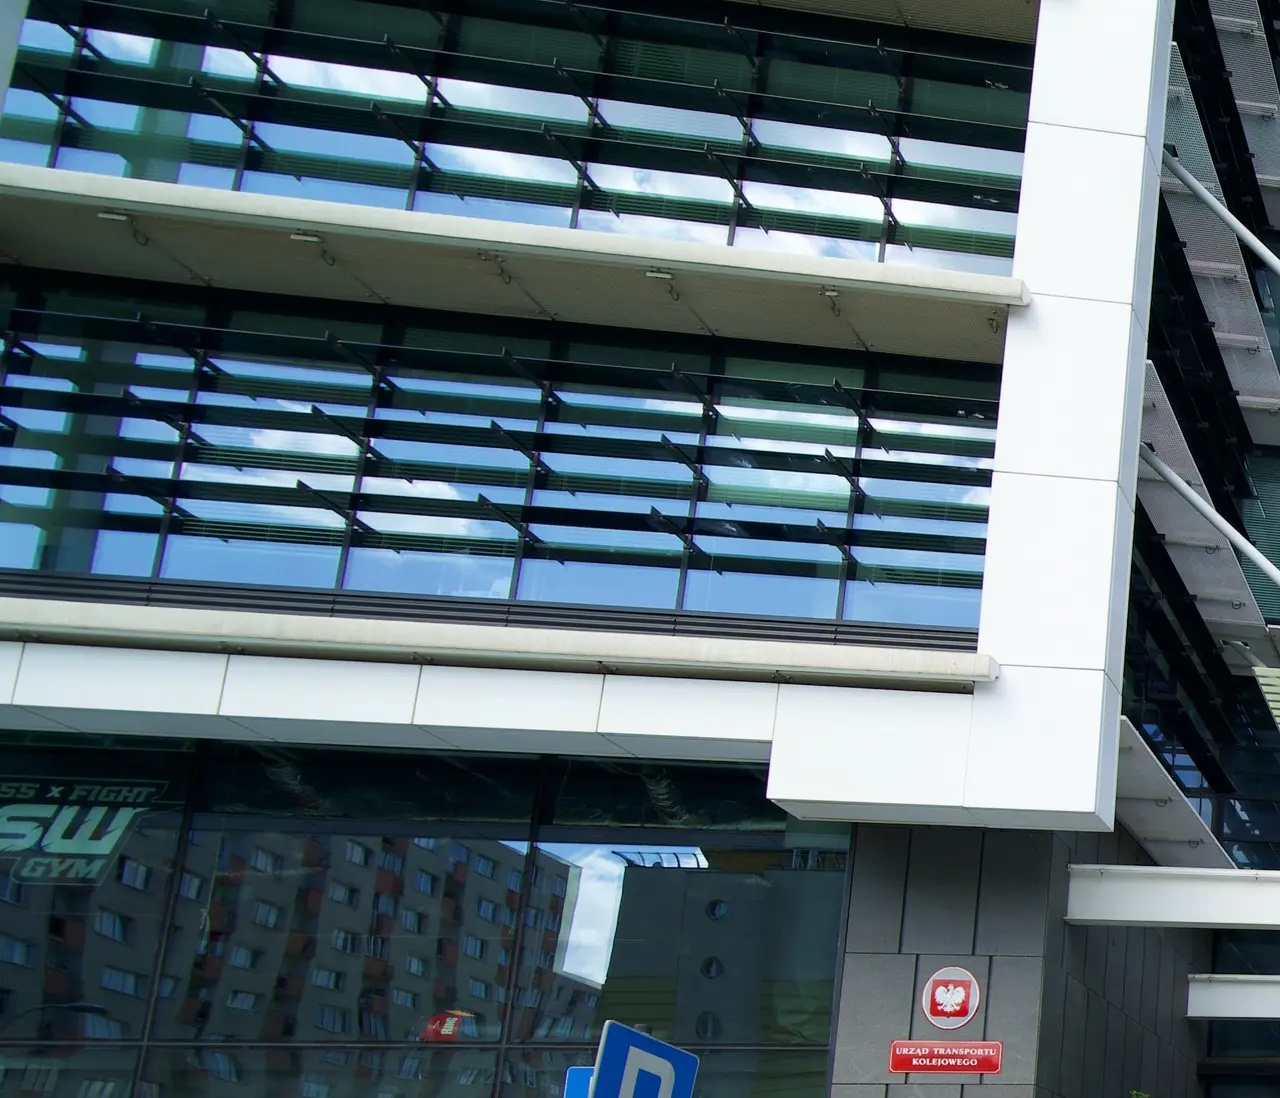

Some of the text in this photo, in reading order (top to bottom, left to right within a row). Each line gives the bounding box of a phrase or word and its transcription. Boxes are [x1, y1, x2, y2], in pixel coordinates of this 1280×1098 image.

[68, 784, 157, 803] FIGHT
[19, 857, 107, 880] GYM
[896, 1047, 997, 1056] URZĄD TRANSPORTU
[912, 1058, 978, 1066] KOLEJOWEGO
